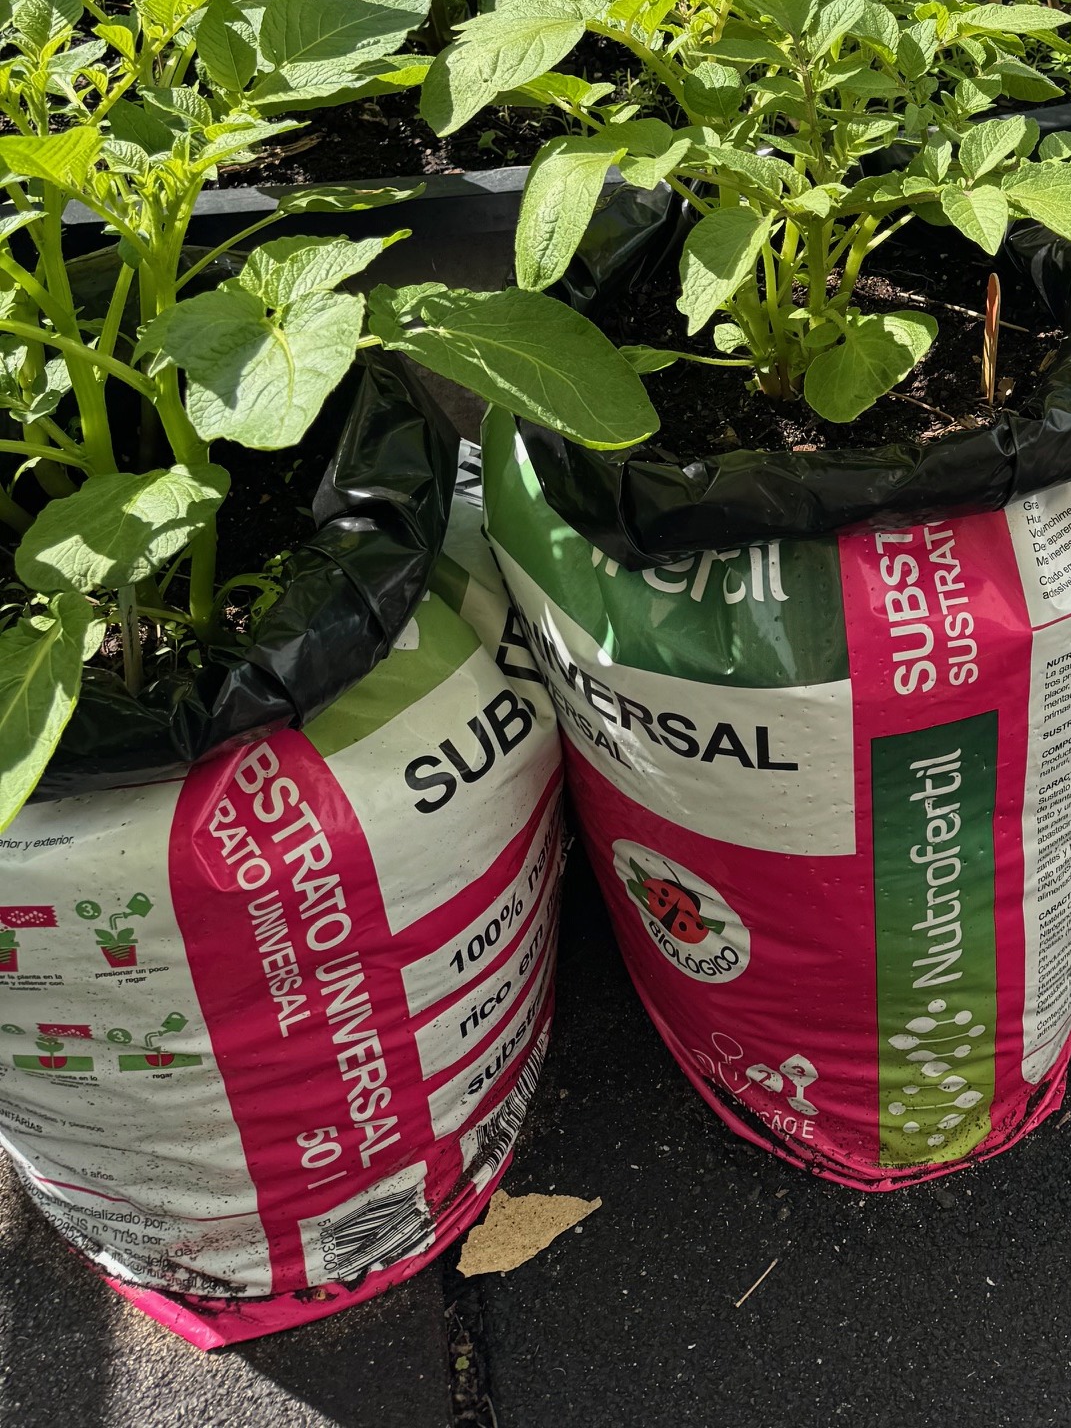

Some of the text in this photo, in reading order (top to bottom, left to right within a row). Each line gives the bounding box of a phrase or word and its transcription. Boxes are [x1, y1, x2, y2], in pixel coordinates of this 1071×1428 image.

[924, 522, 979, 686] SUSTRAT
[1044, 678, 1060, 689] tros
[1044, 704, 1071, 723] primas
[405, 689, 536, 814] SUB
[1038, 784, 1070, 805] Sustrato
[1037, 811, 1055, 824] trato
[23, 840, 32, 851] y
[33, 835, 74, 848] exterior.
[912, 746, 963, 991] Nutrofertil
[208, 794, 311, 1037] RATO UNIVERSAL
[450, 892, 524, 974] 100%
[649, 920, 739, 977] BIOLÓGICO
[95, 968, 134, 979] presionar
[148, 966, 169, 974] poco
[125, 976, 147, 984] regar
[459, 980, 512, 1039] rico
[518, 923, 544, 977] em
[315, 951, 401, 1168] UNIVERSAL
[802, 1120, 815, 1138] E
[296, 1126, 342, 1169] 50
[90, 1171, 117, 1181] años.
